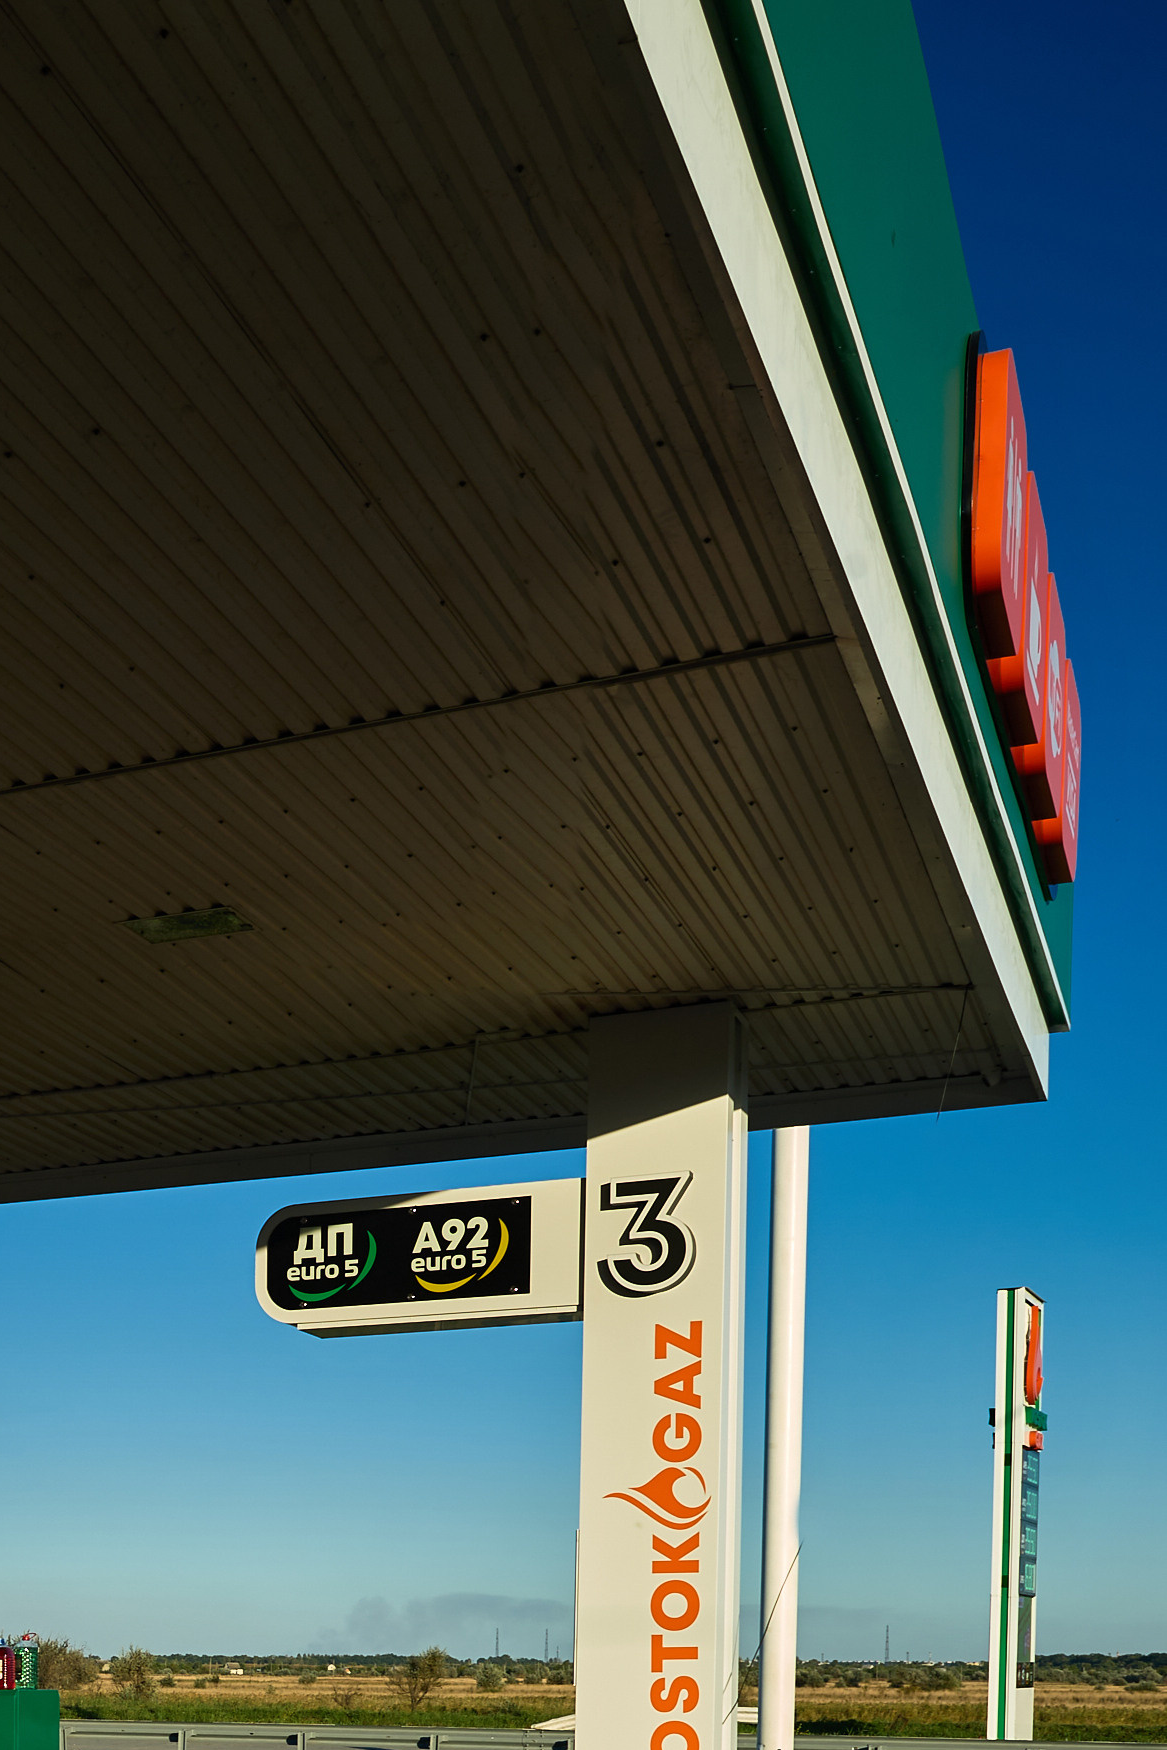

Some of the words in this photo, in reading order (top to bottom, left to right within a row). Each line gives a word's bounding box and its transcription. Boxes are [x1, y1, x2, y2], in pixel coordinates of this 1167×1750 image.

[294, 1222, 354, 1266] ДП
[412, 1217, 489, 1254] A92
[597, 1171, 696, 1298] 3
[287, 1264, 340, 1282] euro
[345, 1259, 359, 1278] 5
[411, 1255, 467, 1273] euro
[472, 1249, 487, 1268] 5
[652, 1321, 703, 1463] GAZ
